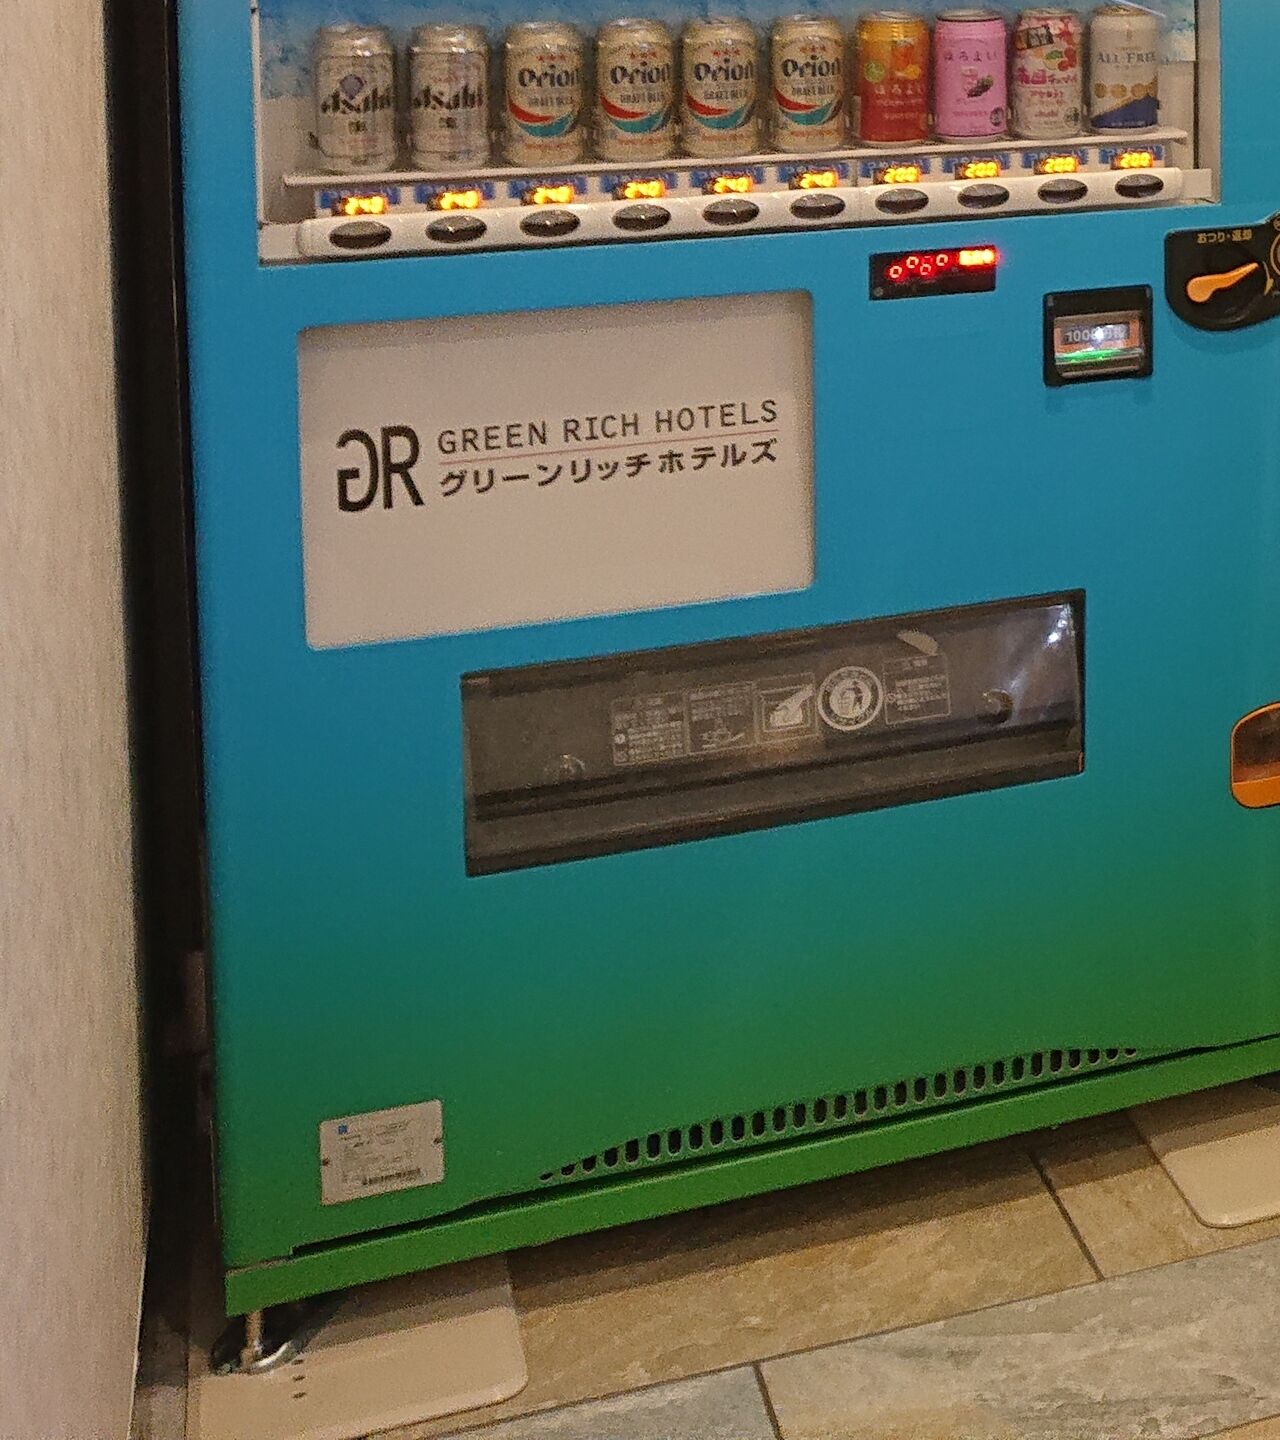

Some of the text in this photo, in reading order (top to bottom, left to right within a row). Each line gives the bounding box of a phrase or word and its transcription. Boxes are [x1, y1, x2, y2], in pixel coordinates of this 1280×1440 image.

[518, 63, 580, 89] Orion
[609, 60, 671, 86] Orion
[693, 57, 754, 83] Orion
[781, 54, 840, 79] Orion
[437, 398, 779, 456] GREEN RICH HOTELS
[439, 437, 779, 498] グリーンリッチホテルズ
